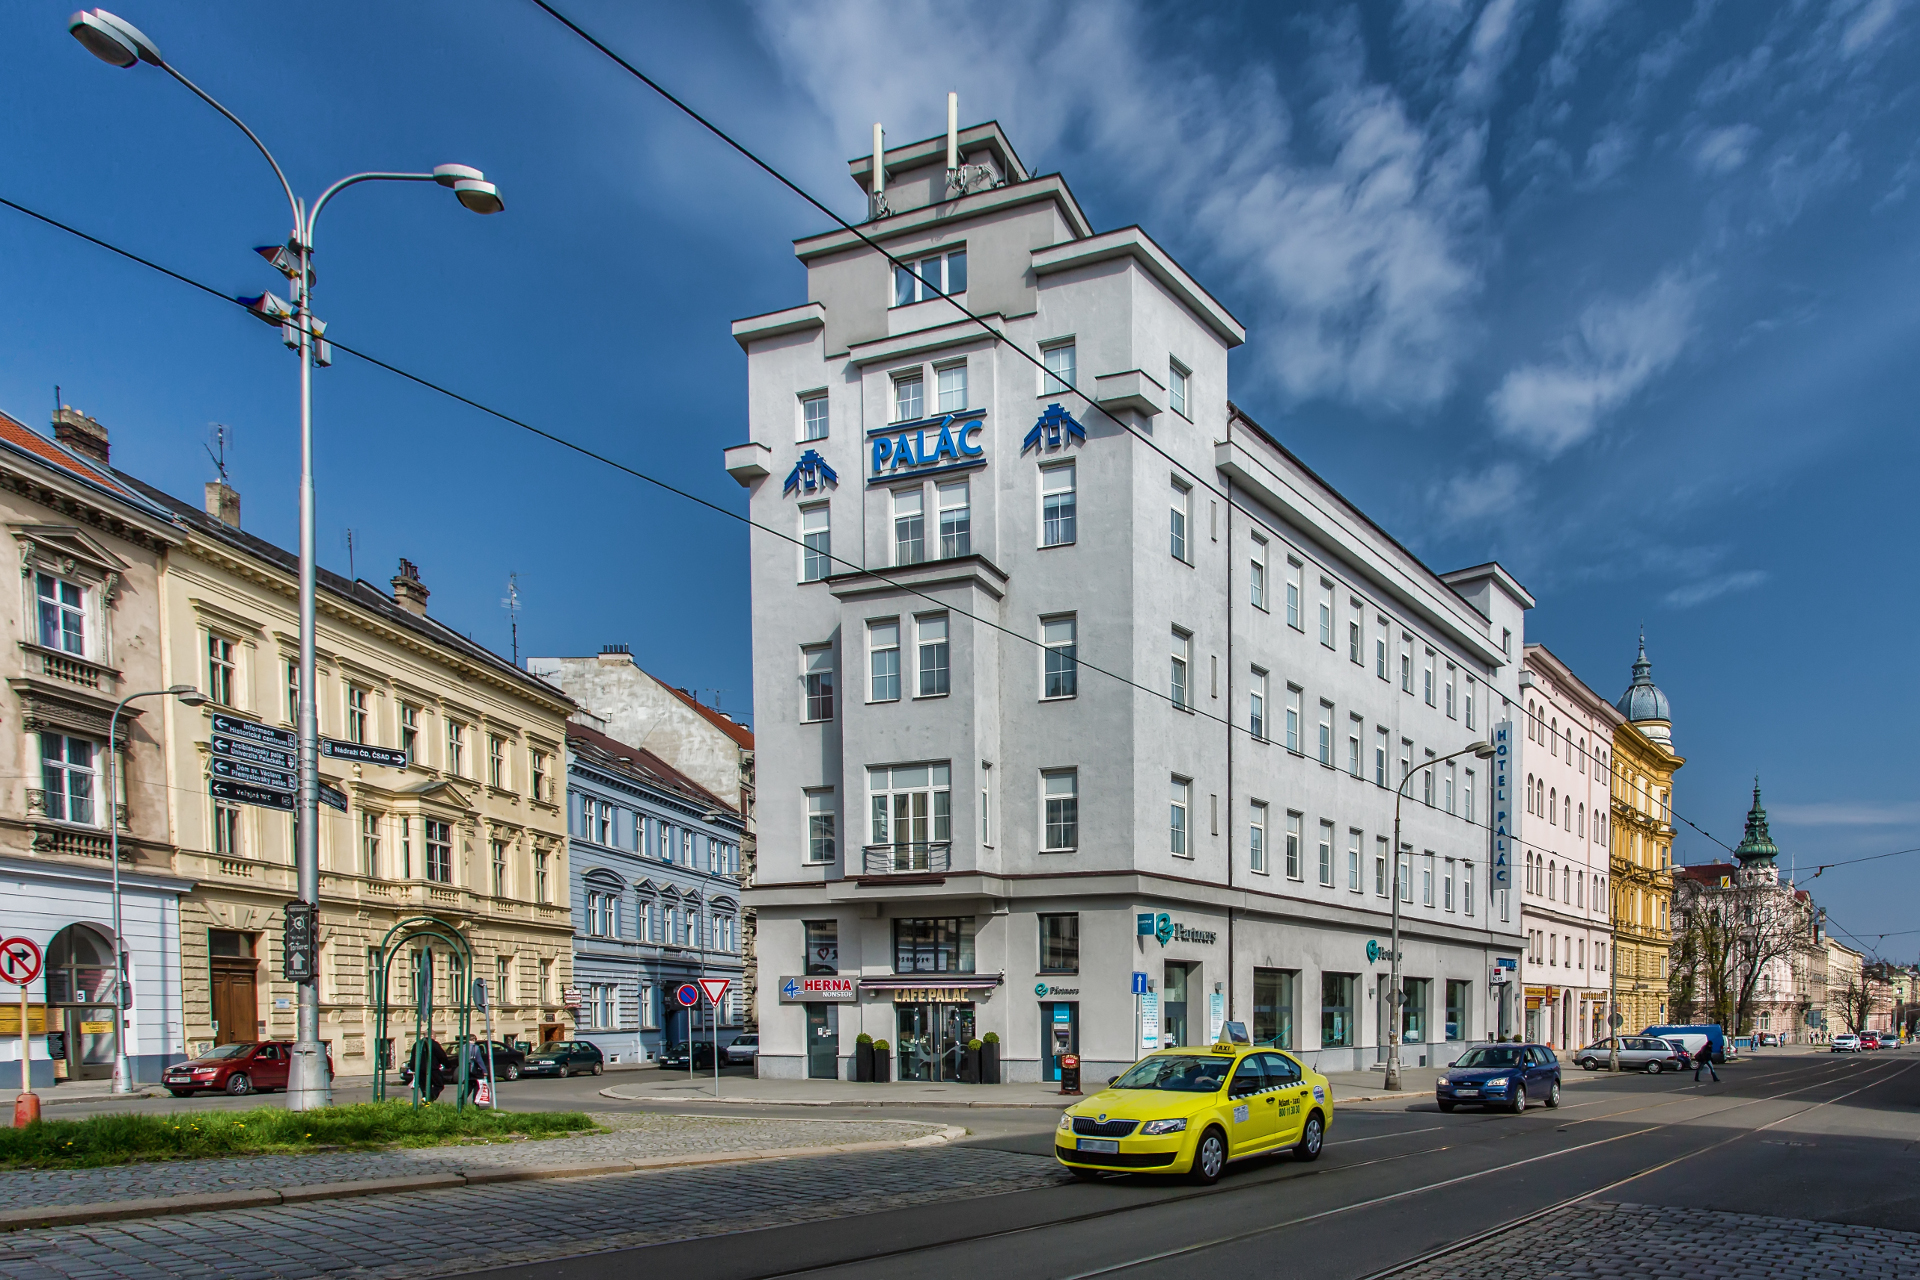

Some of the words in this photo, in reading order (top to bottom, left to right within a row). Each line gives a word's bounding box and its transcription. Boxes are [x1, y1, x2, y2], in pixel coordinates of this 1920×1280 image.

[873, 414, 983, 472] PALÁC
[229, 727, 261, 740] Historické
[262, 735, 288, 746] centrum
[243, 723, 274, 736] Informace
[230, 747, 258, 760] Univerzita
[231, 742, 269, 757] Arcibiskupský
[334, 746, 359, 756] Nádraží
[359, 749, 371, 758] ČD,
[371, 752, 390, 760] ČSAD
[1497, 730, 1507, 801] HOTEL
[1496, 811, 1507, 881] PALÁC
[804, 979, 853, 991] HERNA
[894, 988, 927, 1002] CAFE
